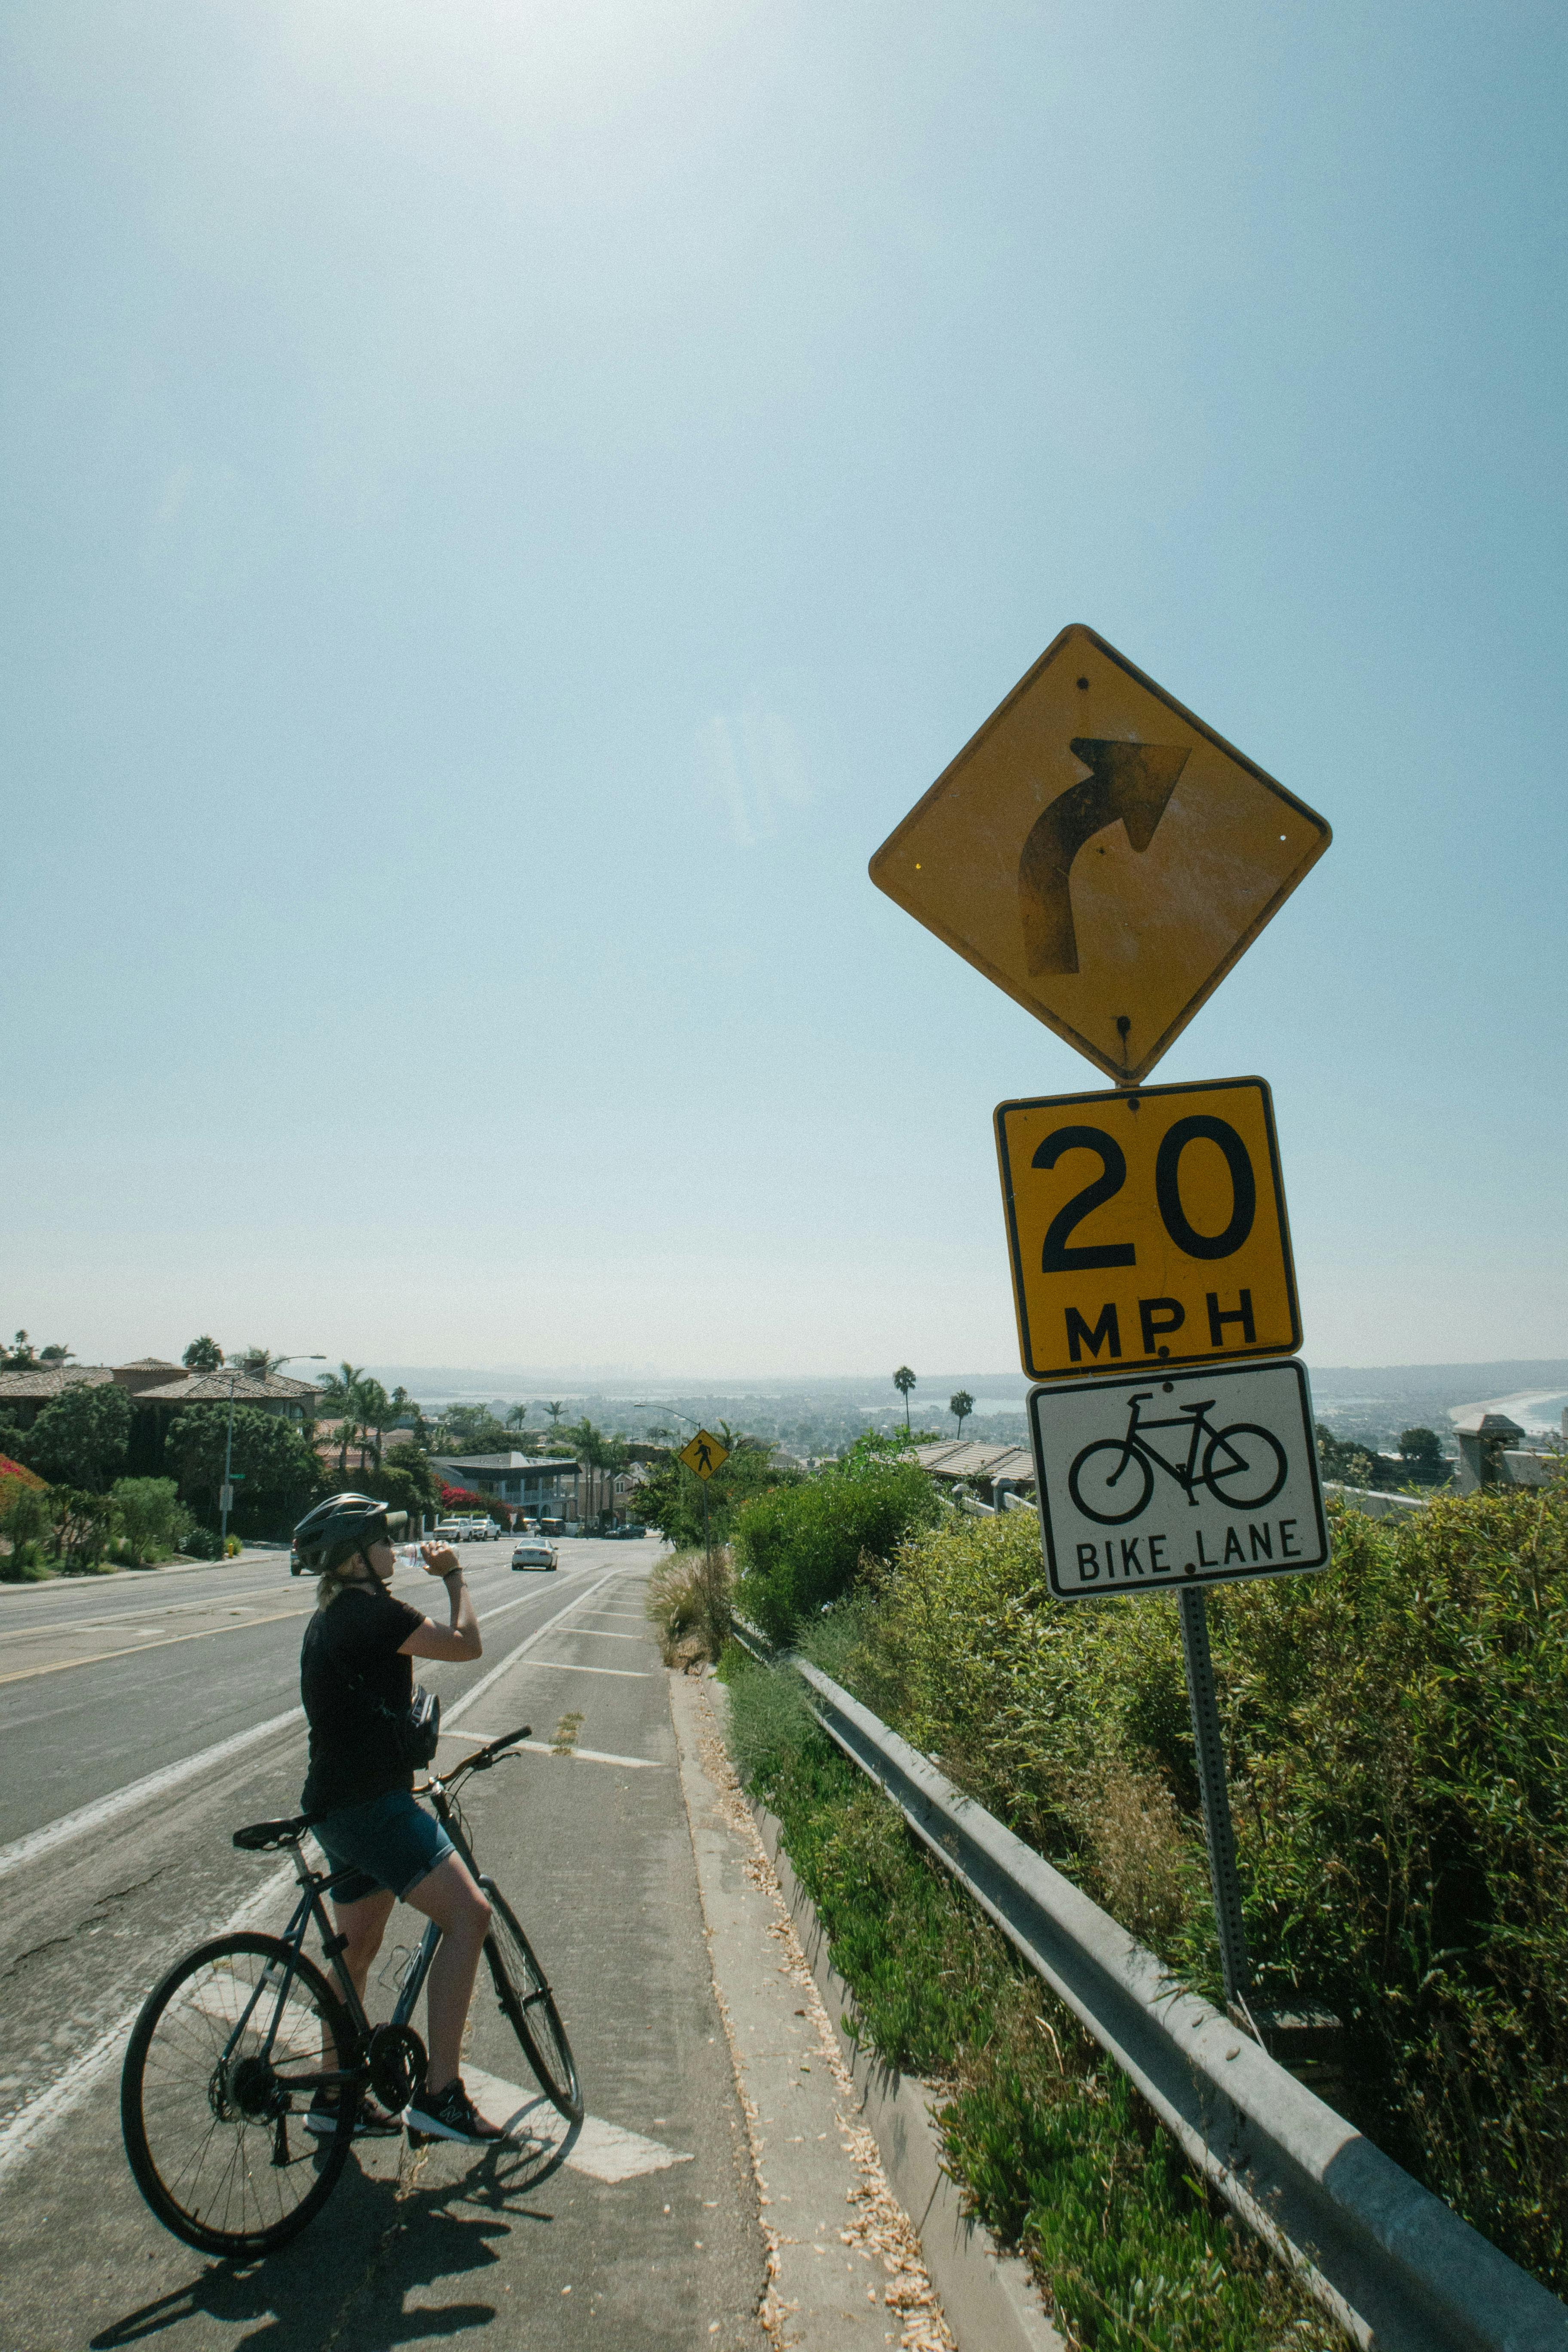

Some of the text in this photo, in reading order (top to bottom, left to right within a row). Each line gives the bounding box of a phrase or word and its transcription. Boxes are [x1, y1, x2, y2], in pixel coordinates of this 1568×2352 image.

[1032, 1116, 1255, 1272] 20
[1065, 1289, 1256, 1362] MPH
[1076, 1519, 1301, 1581] BIKE LANE
